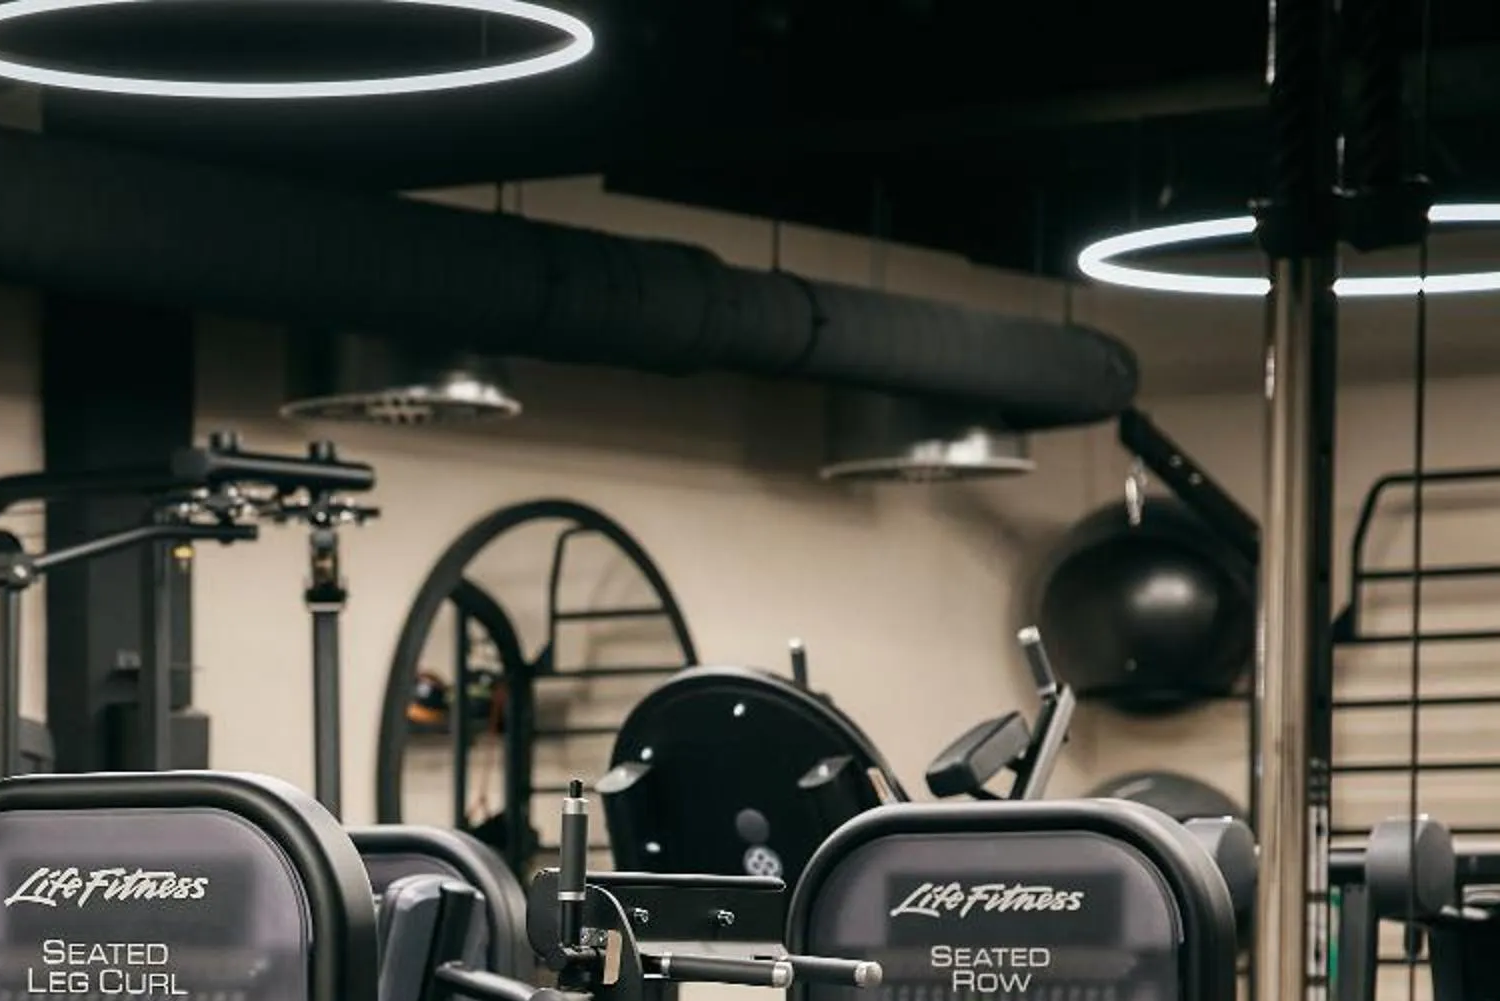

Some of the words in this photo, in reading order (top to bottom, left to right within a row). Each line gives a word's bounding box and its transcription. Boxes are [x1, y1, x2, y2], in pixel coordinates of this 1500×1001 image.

[3, 867, 83, 907] Life
[77, 868, 209, 907] Fitness
[889, 882, 964, 917] Life
[960, 883, 1085, 918] Fitness
[42, 939, 169, 966] SEATED
[931, 945, 1051, 968] SEATED
[27, 967, 90, 994] LEG
[98, 968, 189, 996] CURL
[952, 968, 1033, 993] ROW
